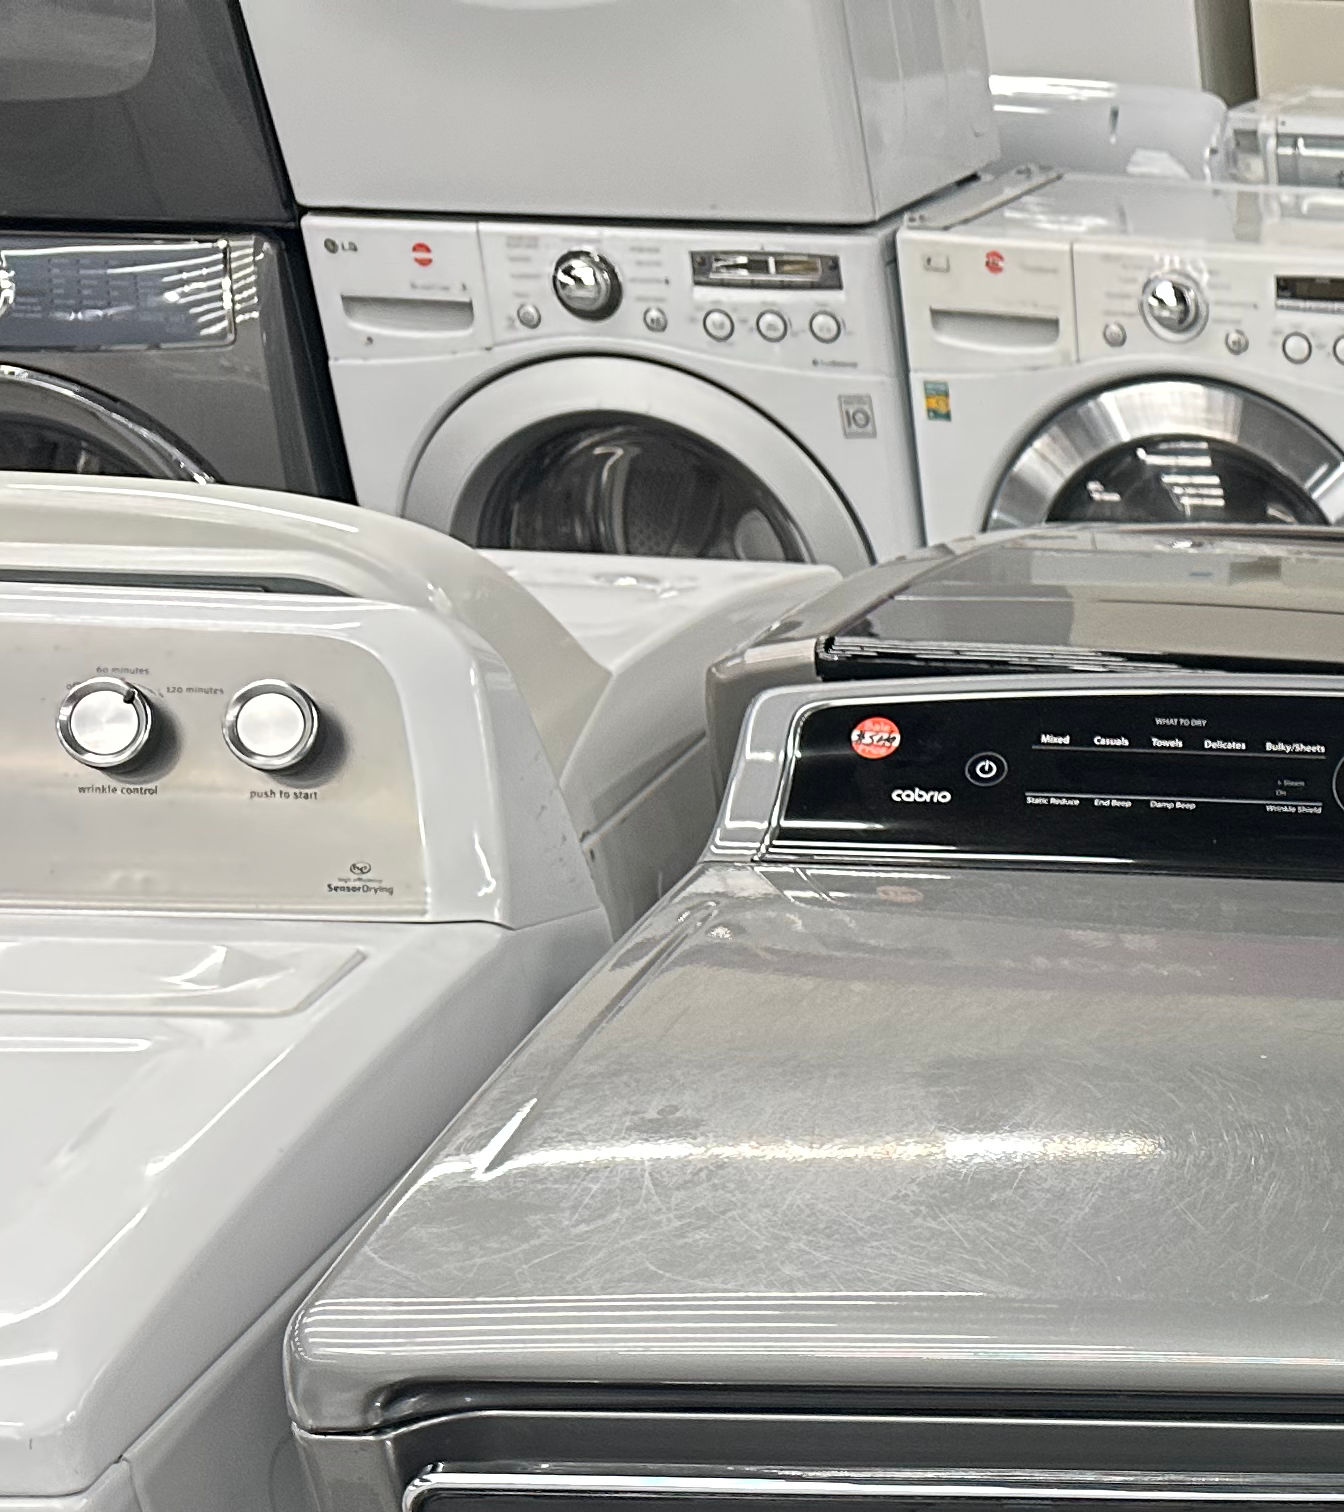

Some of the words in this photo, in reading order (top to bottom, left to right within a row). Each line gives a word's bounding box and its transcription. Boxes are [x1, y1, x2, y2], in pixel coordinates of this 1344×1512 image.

[111, 666, 150, 675] minutes
[166, 686, 183, 694] 120
[185, 686, 224, 695] minutes
[1155, 717, 1179, 727] WHAT
[1179, 718, 1190, 727] TO
[1040, 733, 1070, 745] Mixed
[1093, 736, 1129, 747] Casuals
[1151, 737, 1183, 748] Towels
[1204, 739, 1246, 750] Delicates
[1265, 741, 1326, 754] Bulky/Sheets
[78, 785, 118, 795] wrinkle
[120, 785, 158, 795] control
[249, 789, 276, 800] push
[279, 790, 291, 800] to
[293, 790, 318, 800] start
[891, 787, 952, 803] cabrio
[1050, 797, 1080, 806] Reduce
[1094, 798, 1110, 808] End
[1111, 799, 1132, 810] Beep
[1150, 800, 1174, 811] Damp
[327, 883, 394, 896] SensorDrying
